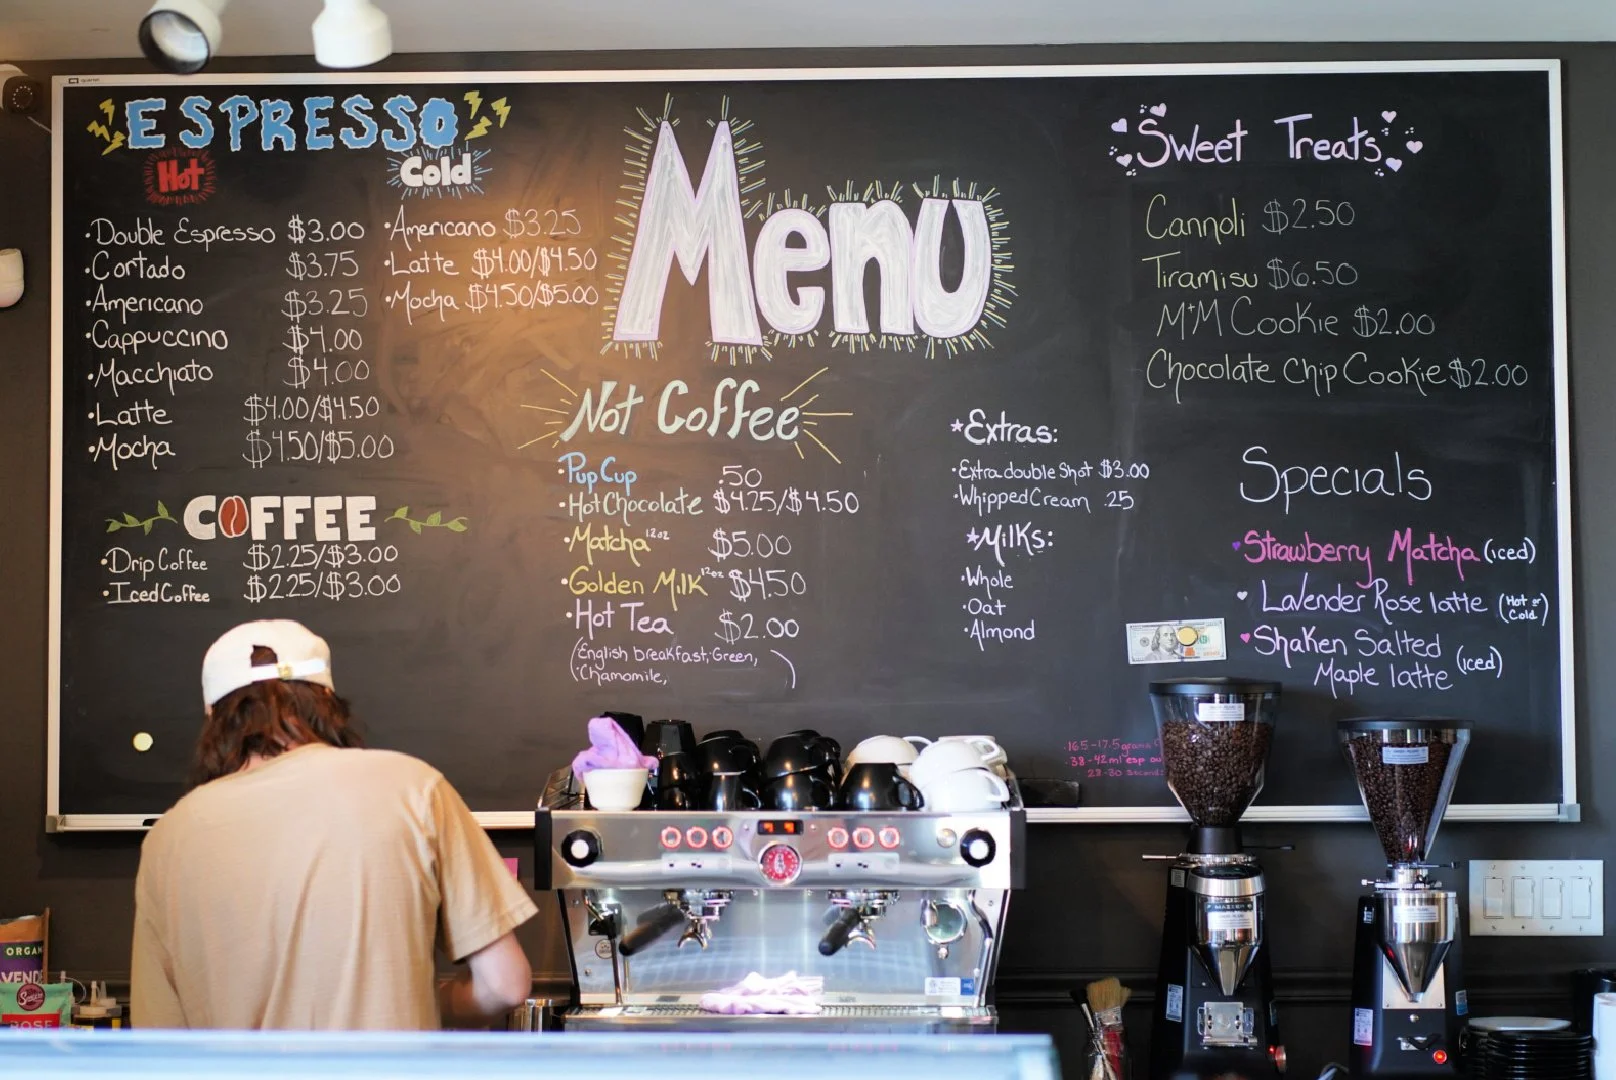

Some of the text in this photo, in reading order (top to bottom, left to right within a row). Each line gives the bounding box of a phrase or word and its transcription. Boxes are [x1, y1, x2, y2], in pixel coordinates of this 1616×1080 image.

[125, 94, 459, 152] ESPRESSO
[1137, 113, 1382, 168] Sweet Treats
[156, 157, 205, 193] Hot
[400, 152, 472, 187] Cold
[90, 214, 365, 252] Double Espresso $3.00
[389, 204, 582, 251] Americano $3.25
[613, 120, 992, 346] Menu
[1146, 194, 1356, 245] Cannoli $2.50
[92, 250, 359, 281] Cortado $3.75
[390, 245, 598, 280] Latte $4.00/$4.50
[1142, 251, 1359, 293] Tiramisu $6.50
[92, 283, 368, 325] Americano $3.25
[390, 280, 460, 324] Mocha
[1352, 304, 1436, 338] $2.00
[92, 318, 363, 355] Cappuccino $4.00
[94, 355, 370, 398] Macchiato $4.00
[1146, 348, 1276, 405] Chocolate
[1449, 357, 1529, 388] $2.00
[96, 392, 380, 427] Latte $4.00/$4.50
[559, 377, 800, 442] Not Coffee
[964, 408, 1058, 445] Extras:
[94, 428, 395, 471] Mocha $4.50/$5.00
[958, 458, 1150, 486] Extra double Shot $3.00
[1239, 445, 1433, 515] Specials
[183, 494, 377, 542] COFFEE
[713, 486, 860, 516] $4.25/$4.50
[105, 543, 399, 581] Drip Coffee $2.25/$3.00
[569, 522, 652, 568] Matcha
[707, 527, 792, 563] $5.00
[1244, 527, 1536, 590] Strawberry Matcha (iced)
[107, 570, 402, 604] Iced Coffee $2.25/$3.00
[568, 564, 645, 596] Golden
[728, 566, 807, 603] $4.50
[965, 564, 1014, 600] Whole
[1261, 572, 1367, 613] Lavender
[1374, 577, 1424, 626] Rose
[1429, 591, 1489, 614] latte
[575, 597, 800, 646] Hot Tea $2.00
[967, 598, 1007, 616] Oat
[969, 618, 1036, 652] Almond
[1253, 625, 1442, 669] Shaken Salted
[1313, 644, 1503, 699] Maple latte (iced)
